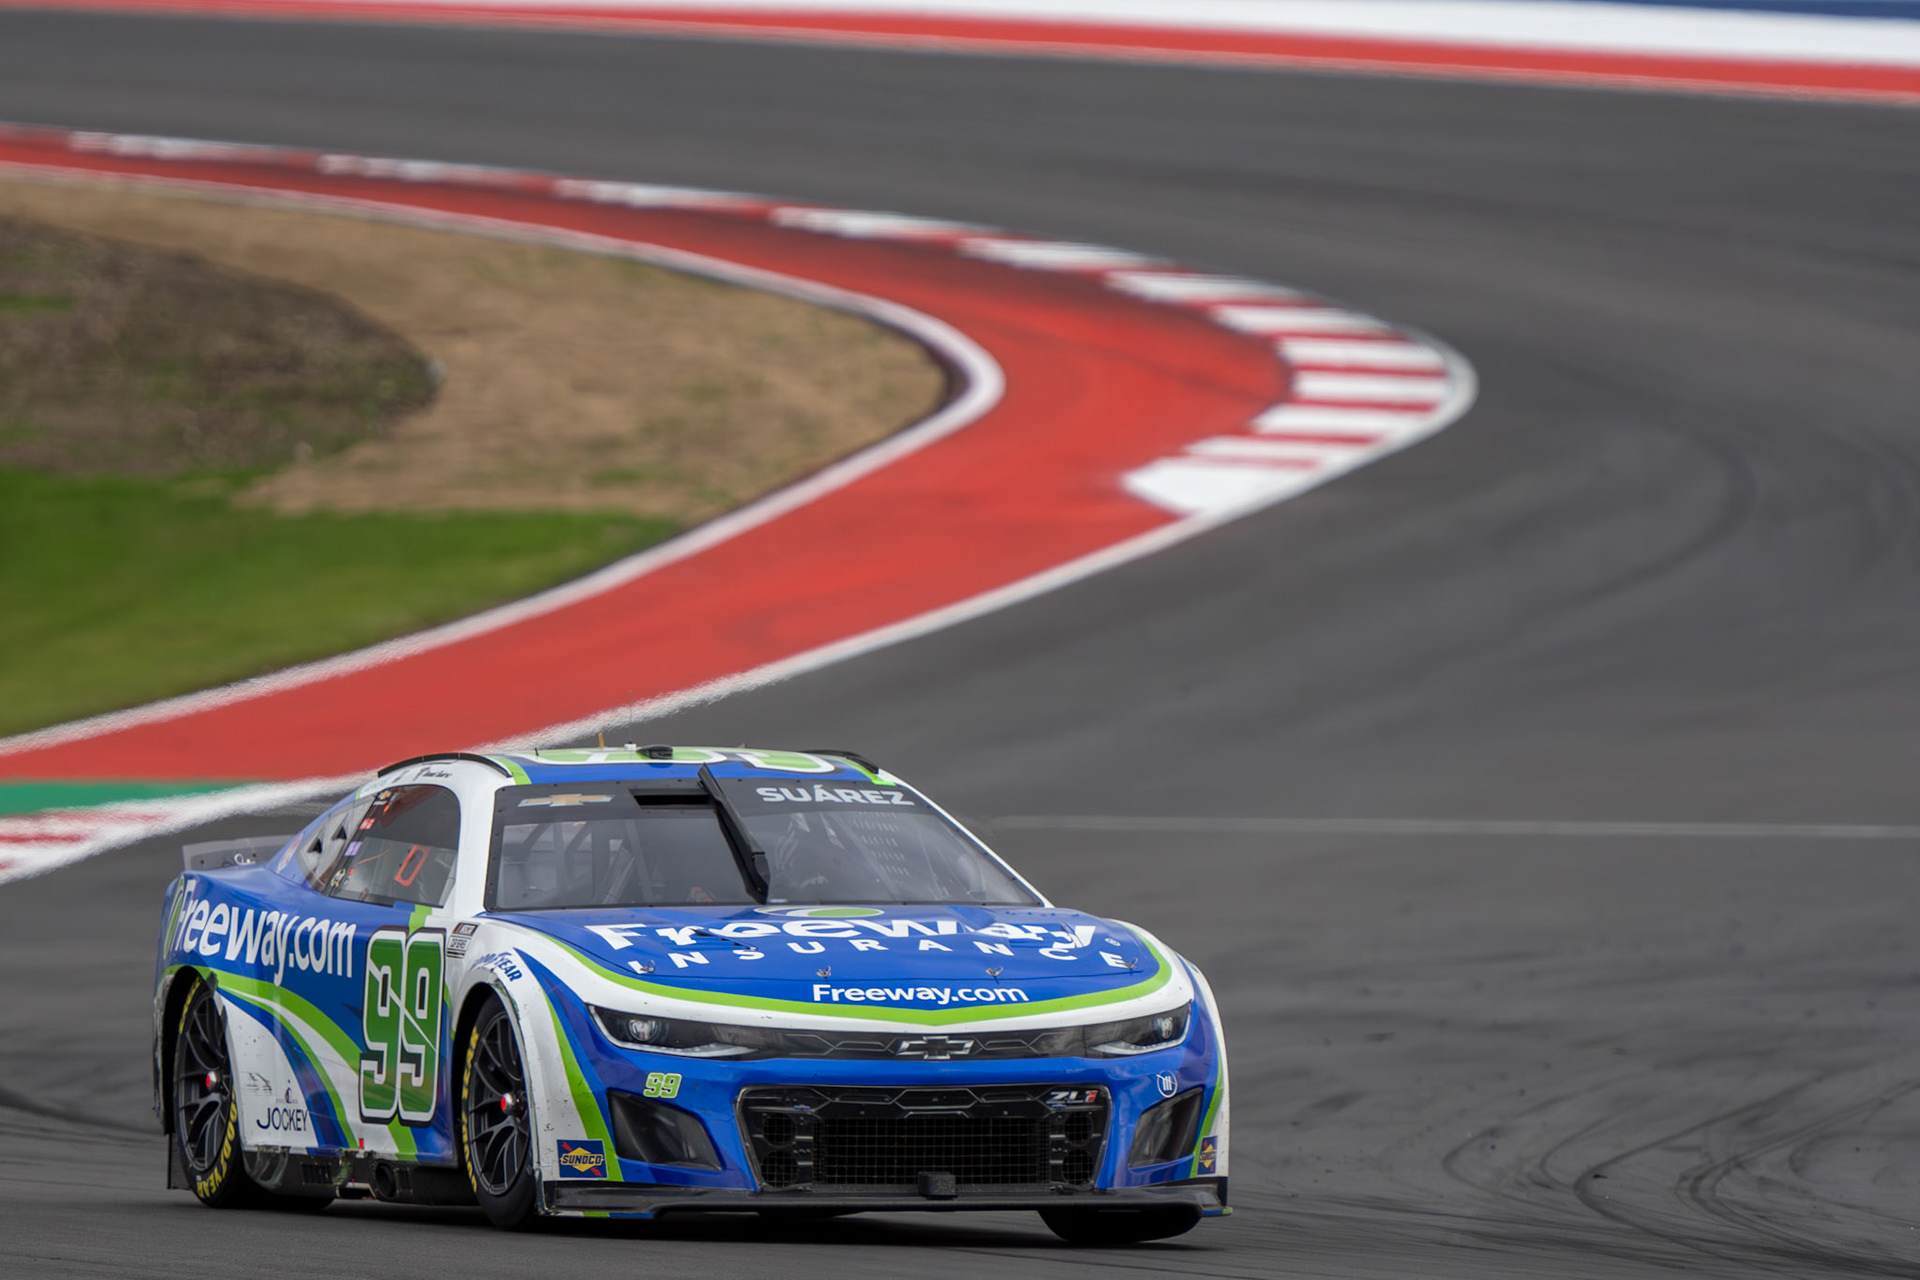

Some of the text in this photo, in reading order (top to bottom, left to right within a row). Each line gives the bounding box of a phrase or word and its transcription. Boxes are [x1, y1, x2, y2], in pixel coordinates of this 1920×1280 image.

[756, 784, 915, 806] SUÁREZ
[173, 879, 357, 987] Freeway.com
[584, 919, 1097, 950] Freeway
[627, 938, 1130, 975] INSURANCE
[813, 984, 1030, 1005] Freeway.com
[360, 927, 447, 1125] 99
[643, 1072, 683, 1098] 99
[1046, 1089, 1098, 1103] ZL1
[256, 1107, 308, 1131] JOCKEY
[561, 1154, 603, 1166] SUNOCO
